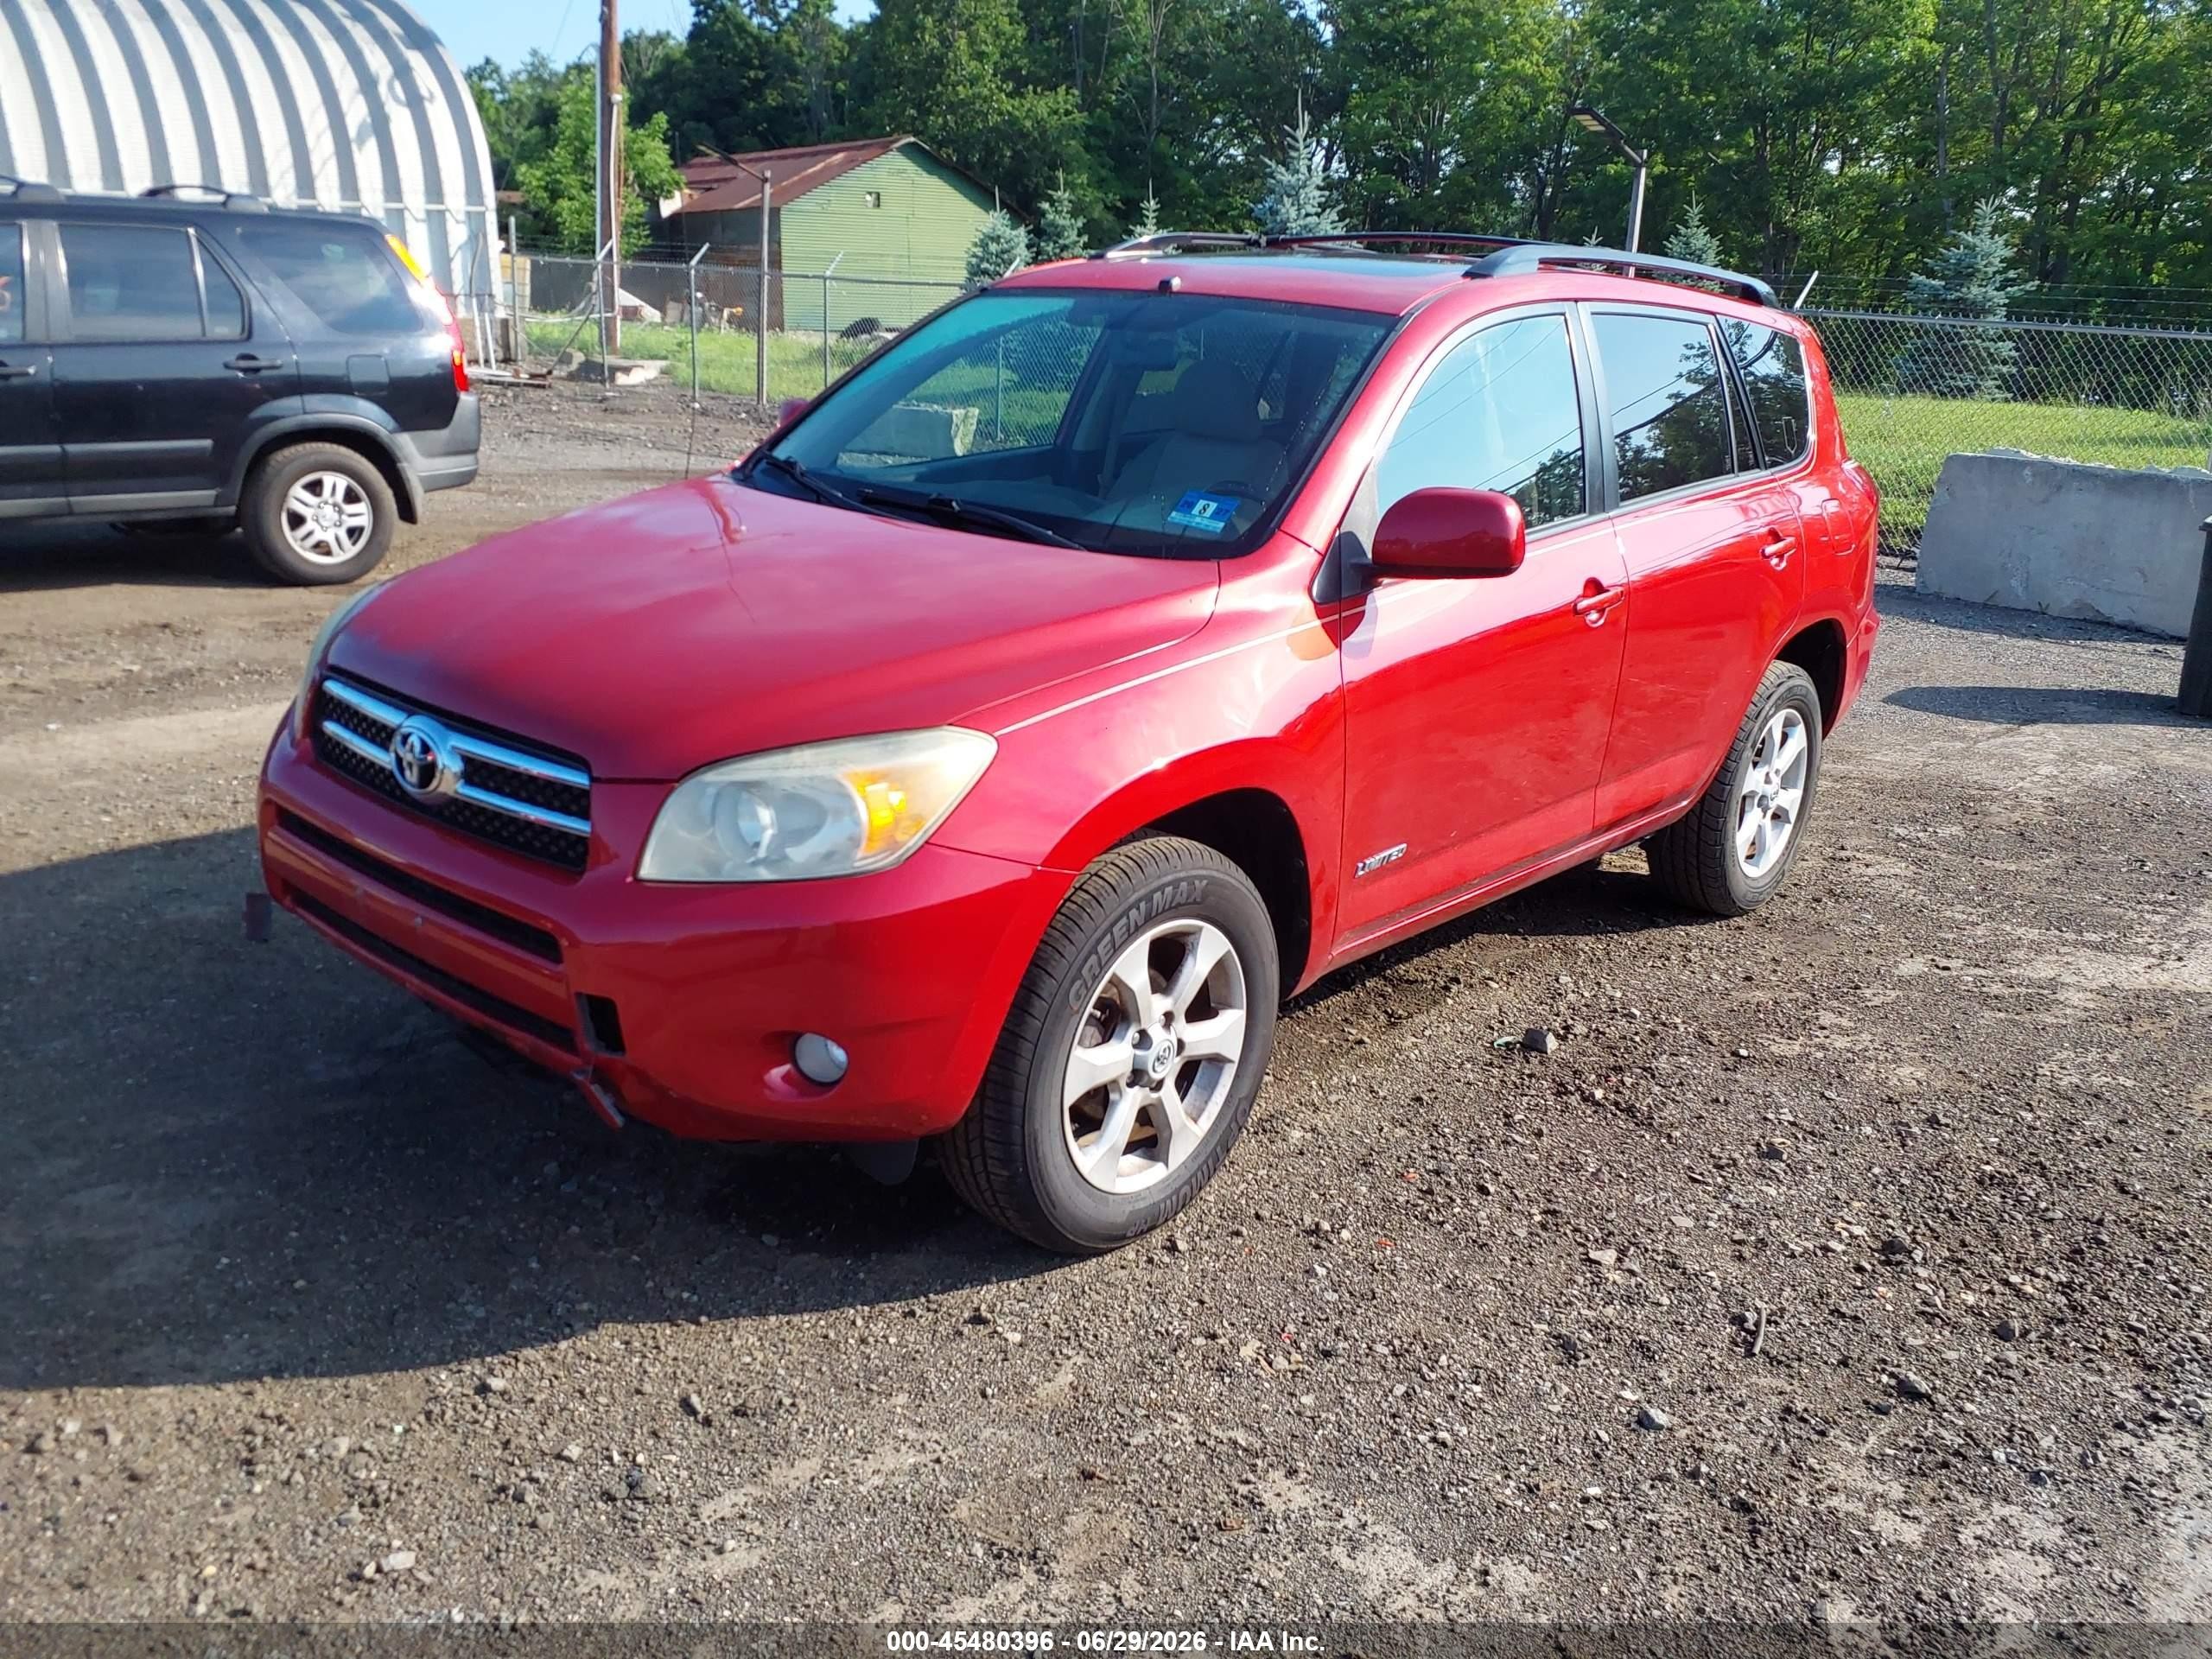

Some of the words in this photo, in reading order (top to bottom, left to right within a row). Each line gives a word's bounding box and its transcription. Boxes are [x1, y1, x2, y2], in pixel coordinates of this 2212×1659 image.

[1198, 503, 1210, 515] 8
[1068, 901, 1147, 1011] GREEN
[1151, 880, 1209, 916] MAX
